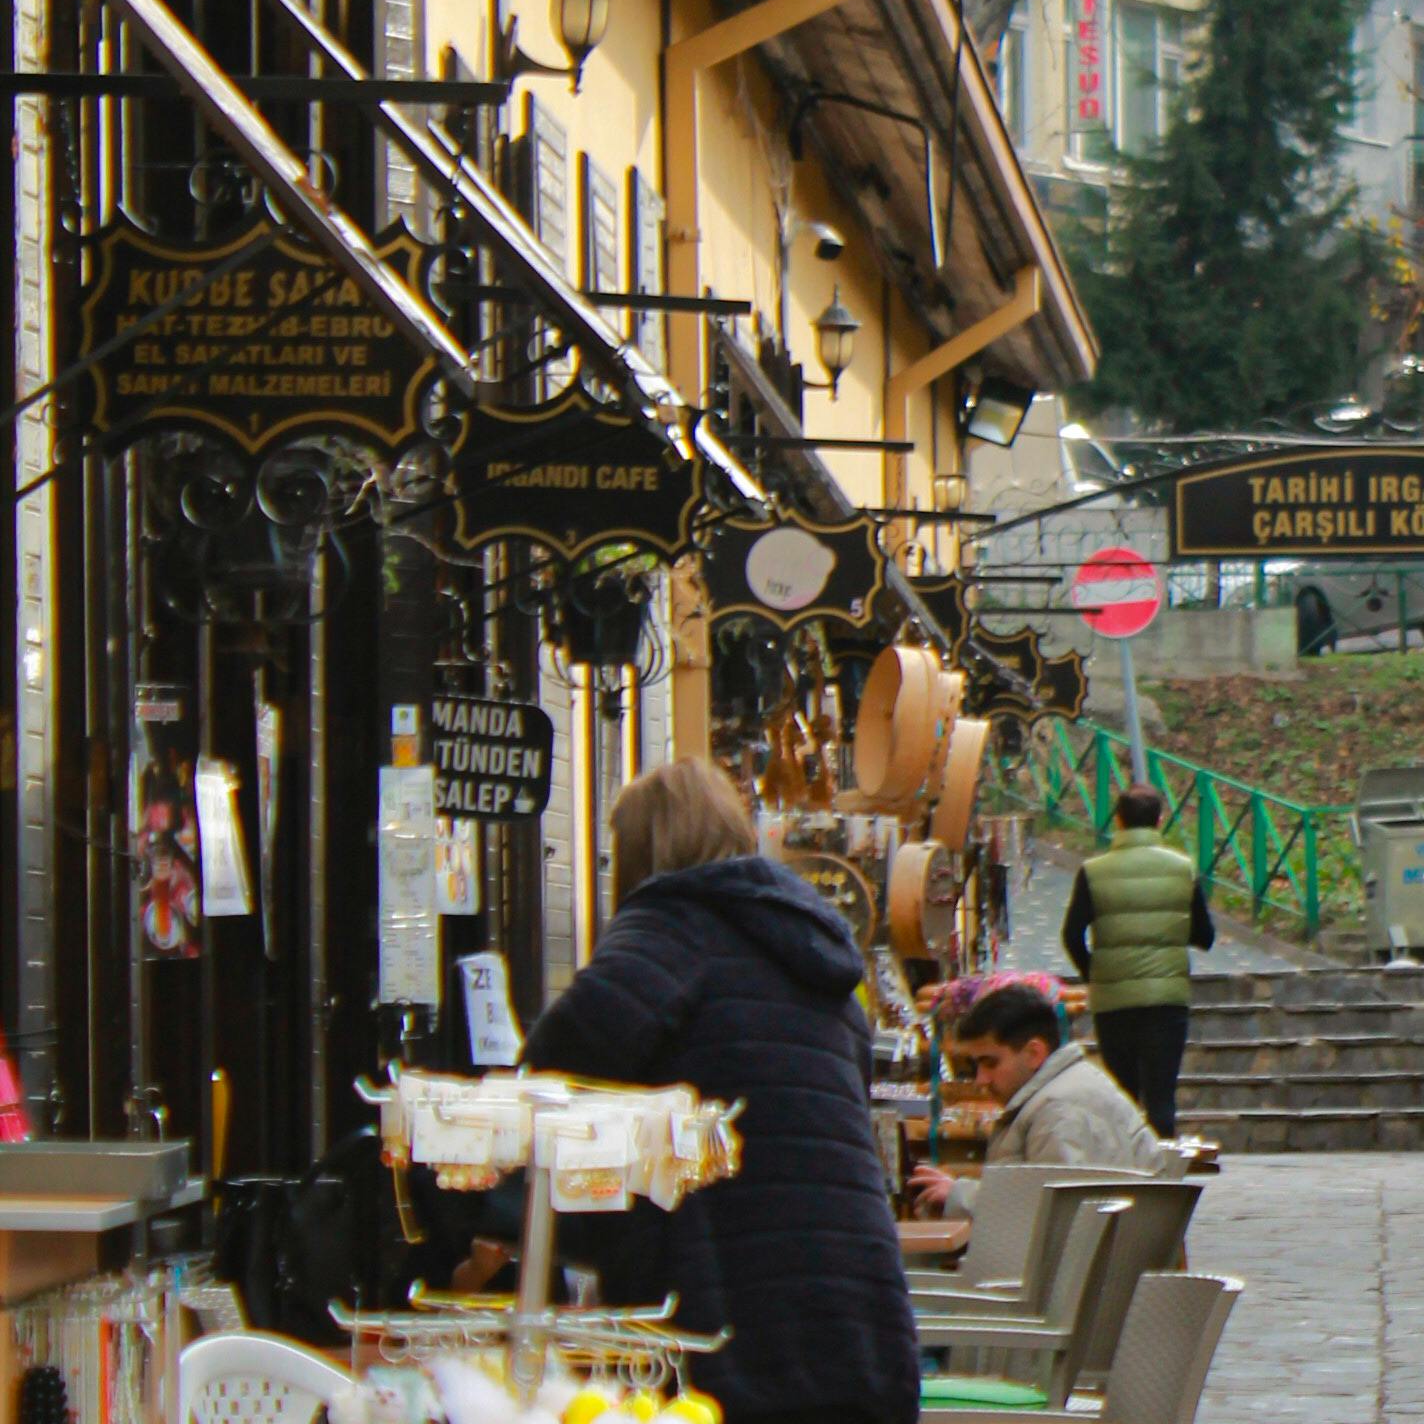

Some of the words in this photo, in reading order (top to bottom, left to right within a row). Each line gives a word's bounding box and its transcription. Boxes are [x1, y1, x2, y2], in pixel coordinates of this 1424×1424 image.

[267, 269, 374, 308] SANA
[134, 345, 166, 365] EL
[332, 345, 368, 366] VE
[596, 464, 660, 491] CAFE
[1249, 471, 1354, 504] TARİHİ
[1253, 509, 1376, 545] ÇARŞILI
[850, 597, 864, 618] 5
[432, 700, 523, 739] MANDA
[434, 738, 542, 779] TÜNDEN
[435, 777, 512, 814] SALEP
